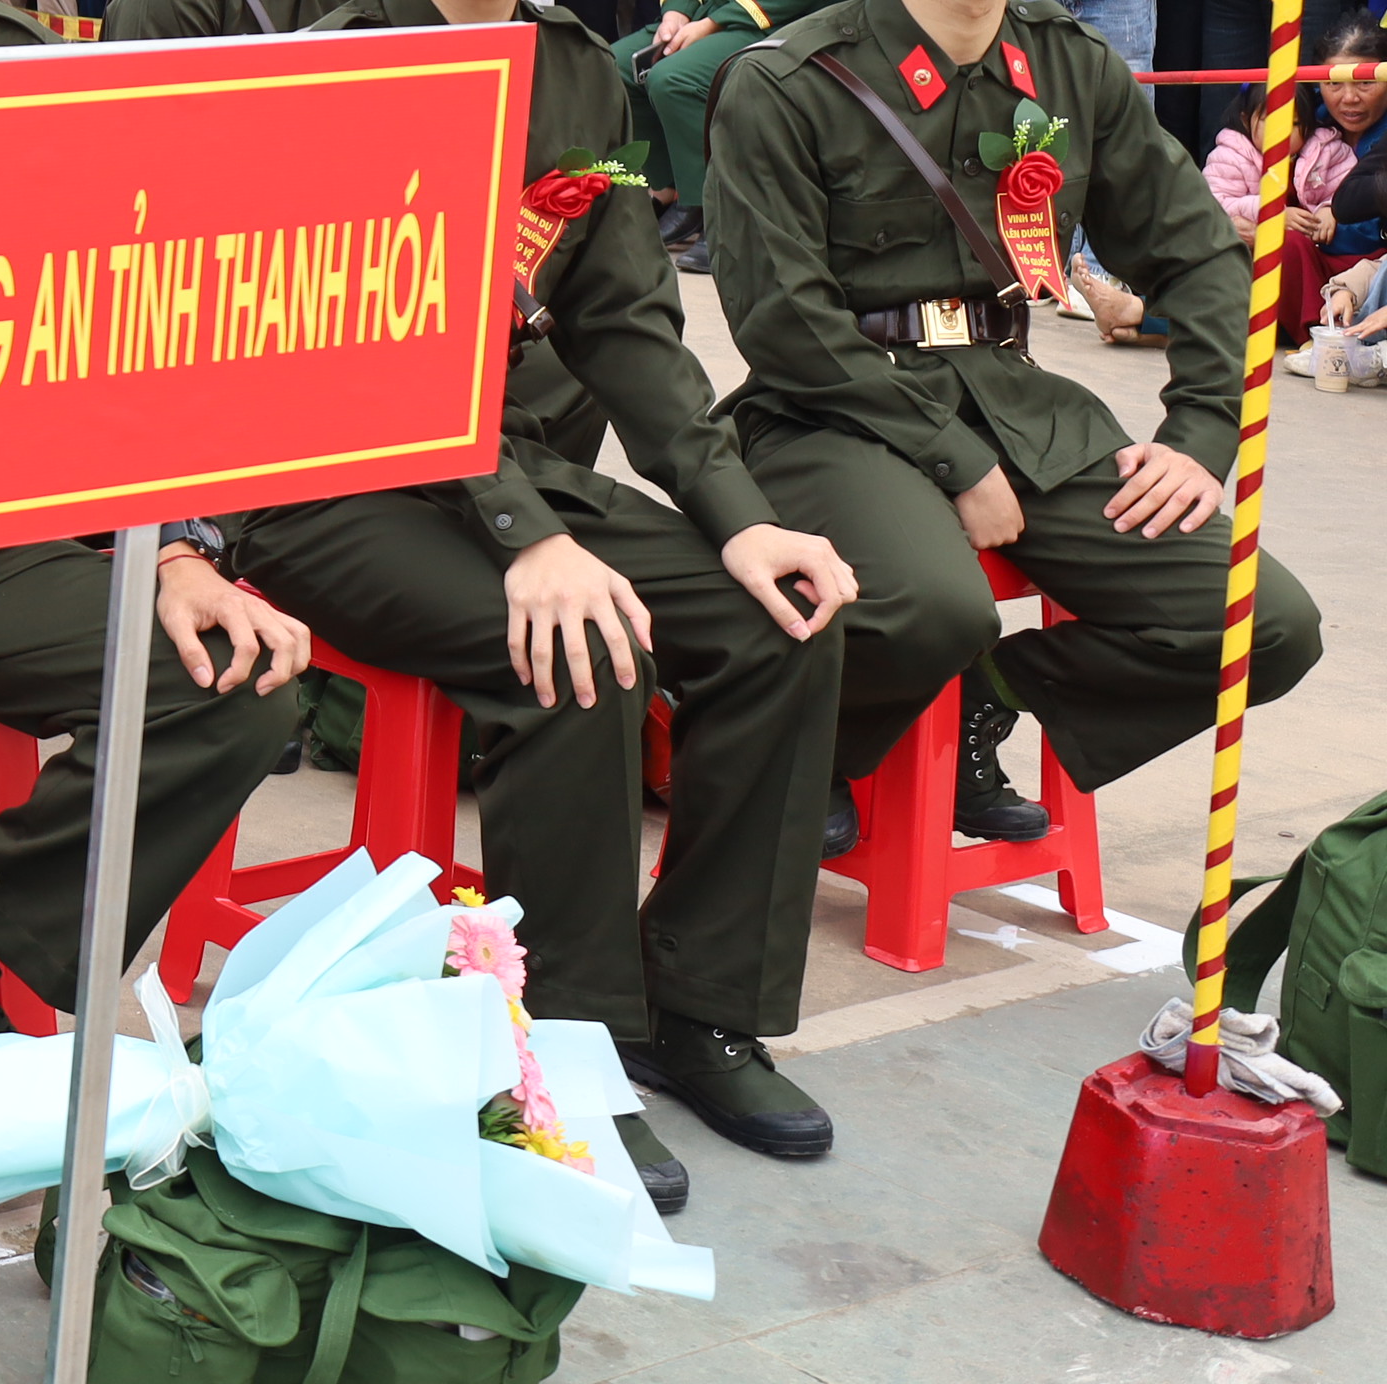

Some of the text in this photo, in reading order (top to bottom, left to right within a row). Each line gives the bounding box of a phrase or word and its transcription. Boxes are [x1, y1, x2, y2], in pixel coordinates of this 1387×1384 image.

[21, 248, 98, 386] AN
[107, 189, 205, 375] TỈNH
[211, 221, 353, 362] THANH
[355, 169, 446, 343] HÓA
